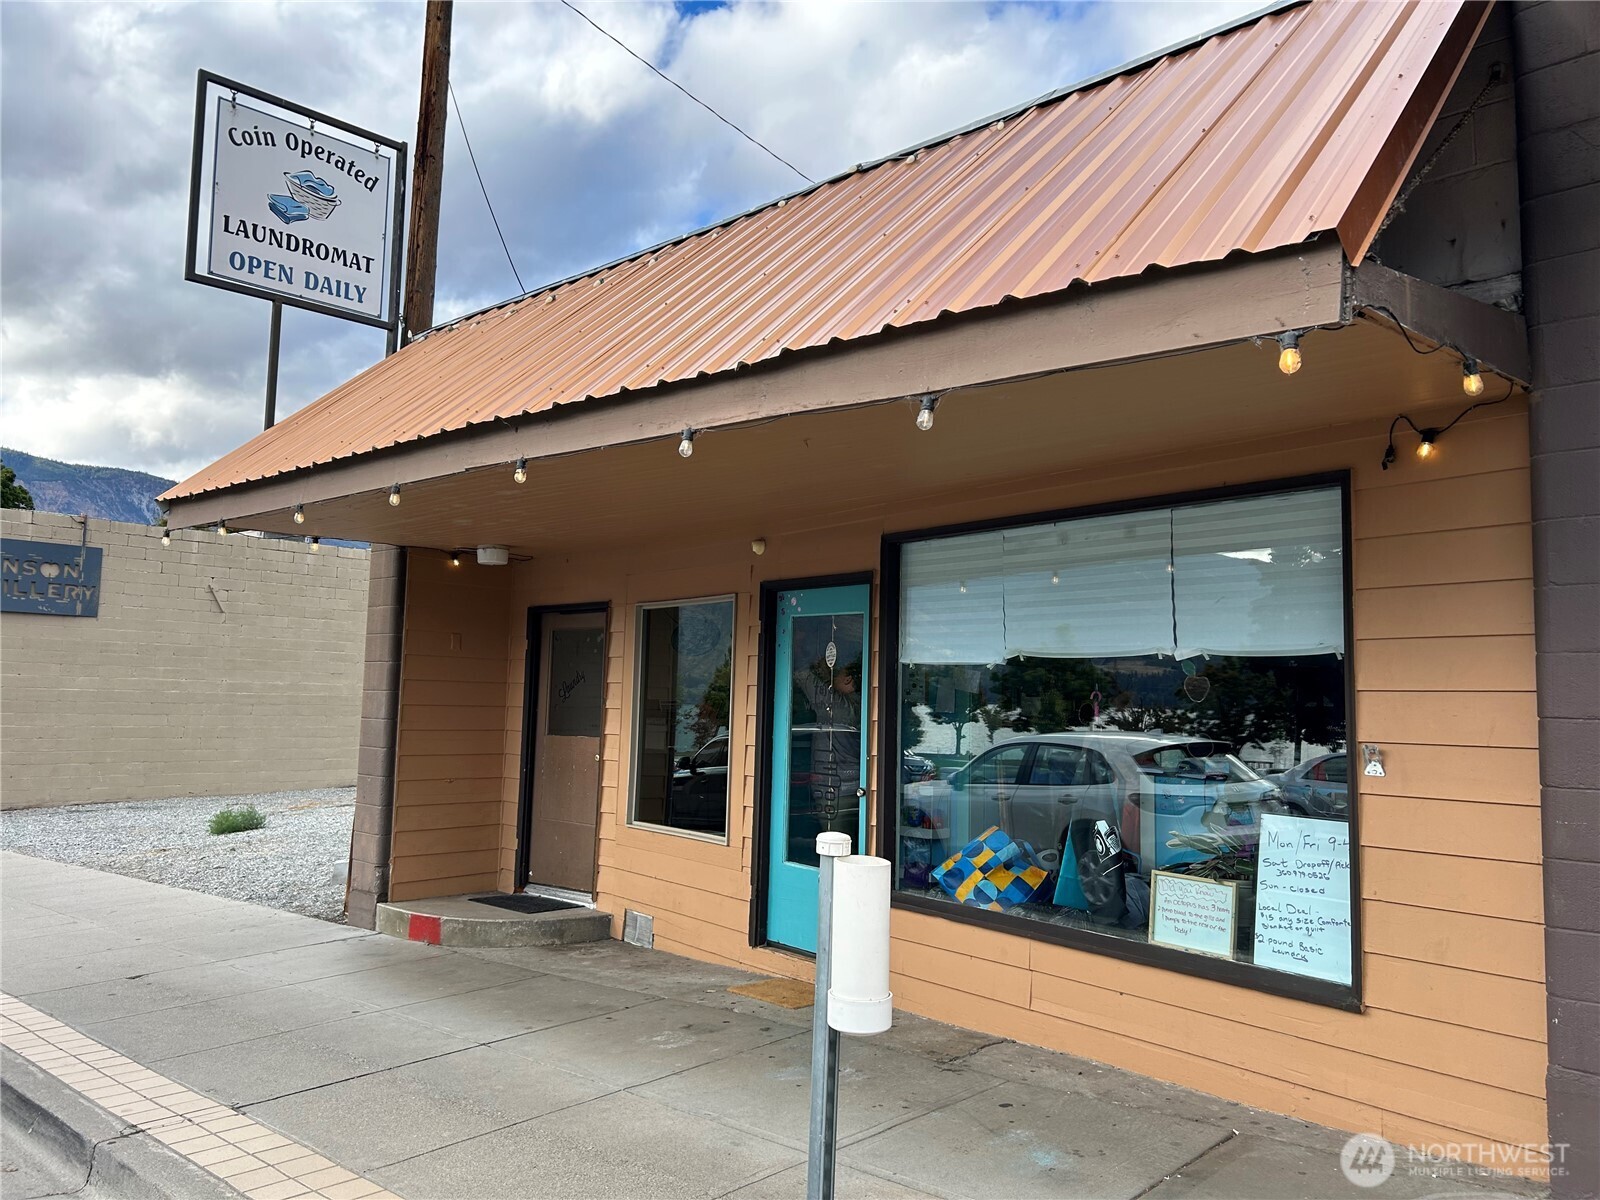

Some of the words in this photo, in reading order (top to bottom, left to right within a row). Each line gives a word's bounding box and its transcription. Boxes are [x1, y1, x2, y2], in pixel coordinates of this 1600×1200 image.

[228, 126, 277, 147] Coin
[285, 132, 380, 193] Operated
[222, 214, 375, 274] LAUNDROMAT
[228, 251, 294, 285] OPEN
[303, 270, 368, 304] DAILY
[1267, 830, 1320, 855] Mon/Fri
[1260, 880, 1279, 890] Sun
[1211, 903, 1217, 913] 3
[1258, 903, 1282, 913] Local
[1286, 903, 1312, 915] Deal
